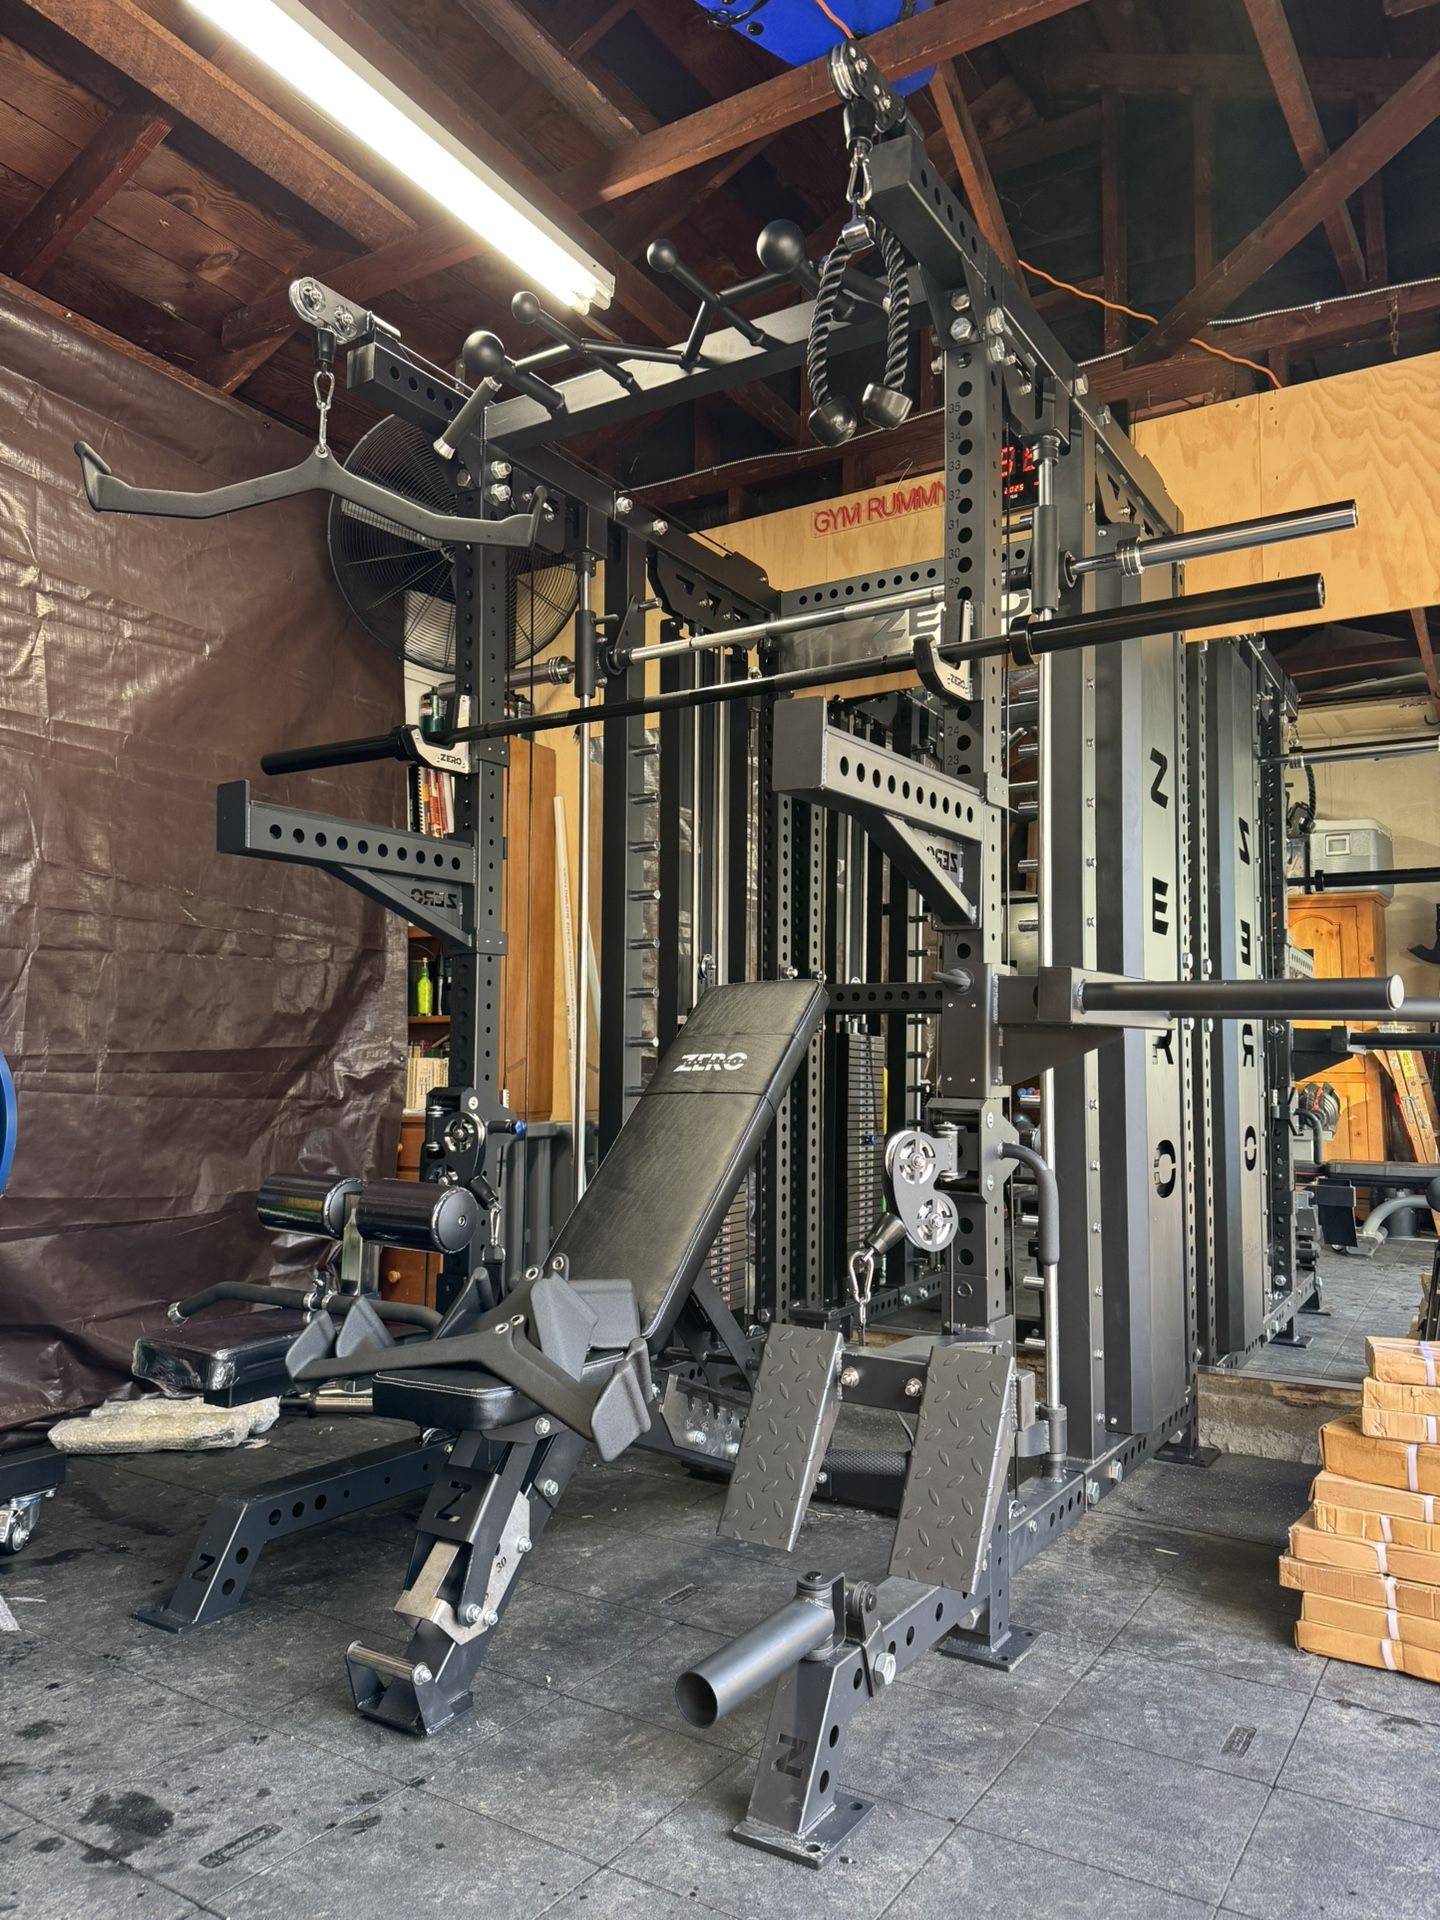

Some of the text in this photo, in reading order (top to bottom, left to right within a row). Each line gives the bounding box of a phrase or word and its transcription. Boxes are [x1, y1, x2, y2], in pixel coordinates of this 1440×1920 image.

[948, 402, 961, 414] 35
[948, 459, 961, 472] 33
[948, 489, 961, 501] 32
[814, 502, 862, 533] GYM
[948, 518, 960, 530] 31
[948, 547, 961, 560] 30
[948, 577, 961, 589] 29
[440, 753, 463, 766] ZERO
[947, 754, 960, 766] 23
[673, 1052, 748, 1073] ZERO
[433, 1480, 473, 1523] Z
[190, 1552, 217, 1583] Z
